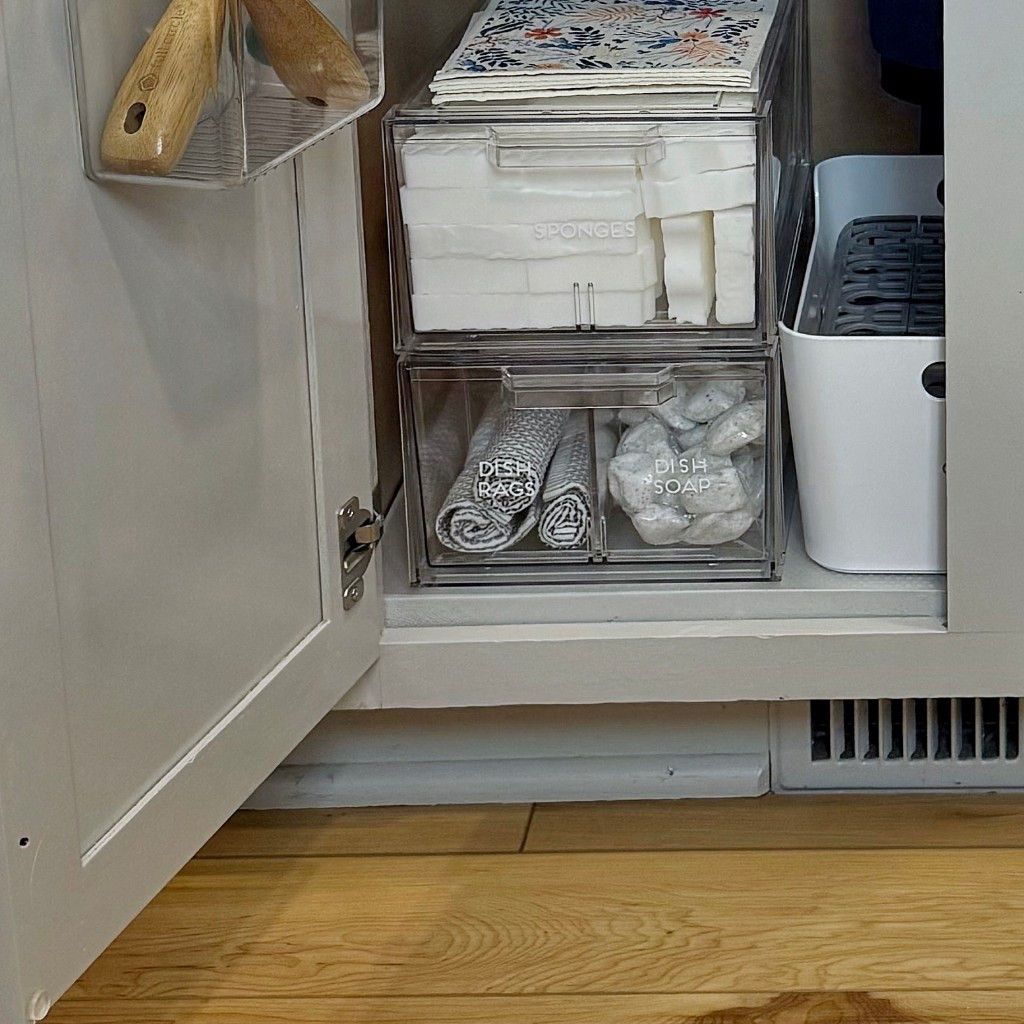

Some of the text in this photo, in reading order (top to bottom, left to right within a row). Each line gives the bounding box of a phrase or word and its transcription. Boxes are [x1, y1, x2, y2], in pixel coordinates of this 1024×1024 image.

[534, 220, 636, 240] SPONGES
[479, 461, 533, 477] DISH
[655, 459, 708, 474] DISH
[479, 480, 535, 497] RAGS
[654, 478, 711, 494] SOAP
